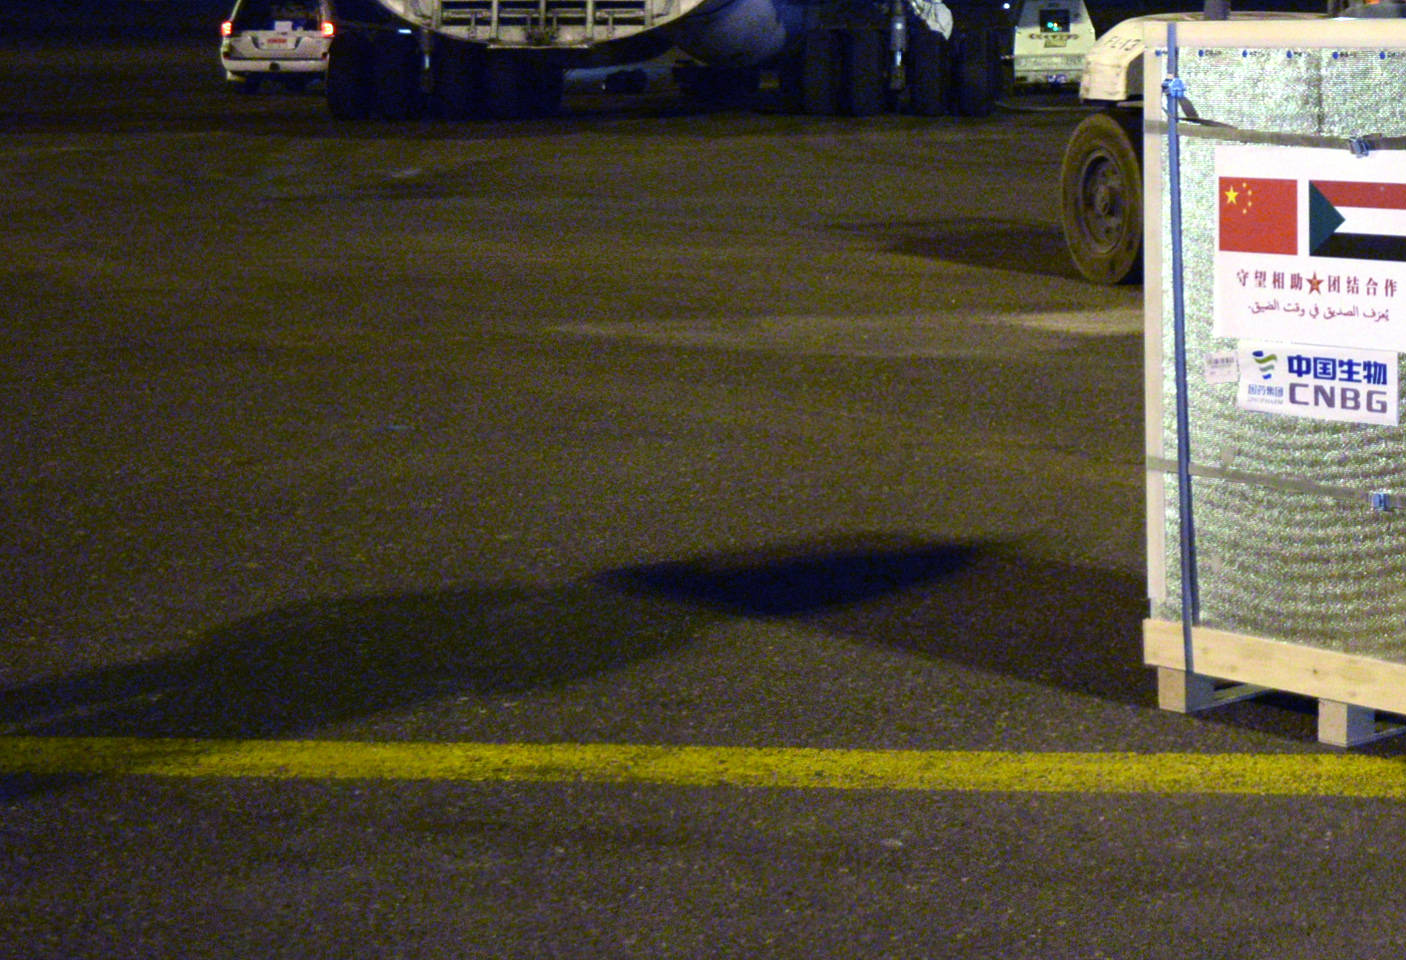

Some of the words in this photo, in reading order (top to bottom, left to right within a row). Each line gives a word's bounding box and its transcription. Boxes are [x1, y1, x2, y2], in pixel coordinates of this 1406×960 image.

[1236, 269, 1303, 291] 守望相助
[1327, 274, 1398, 298] 团结合作
[1287, 354, 1388, 386] 中国生物
[1288, 382, 1388, 414] CNBG
